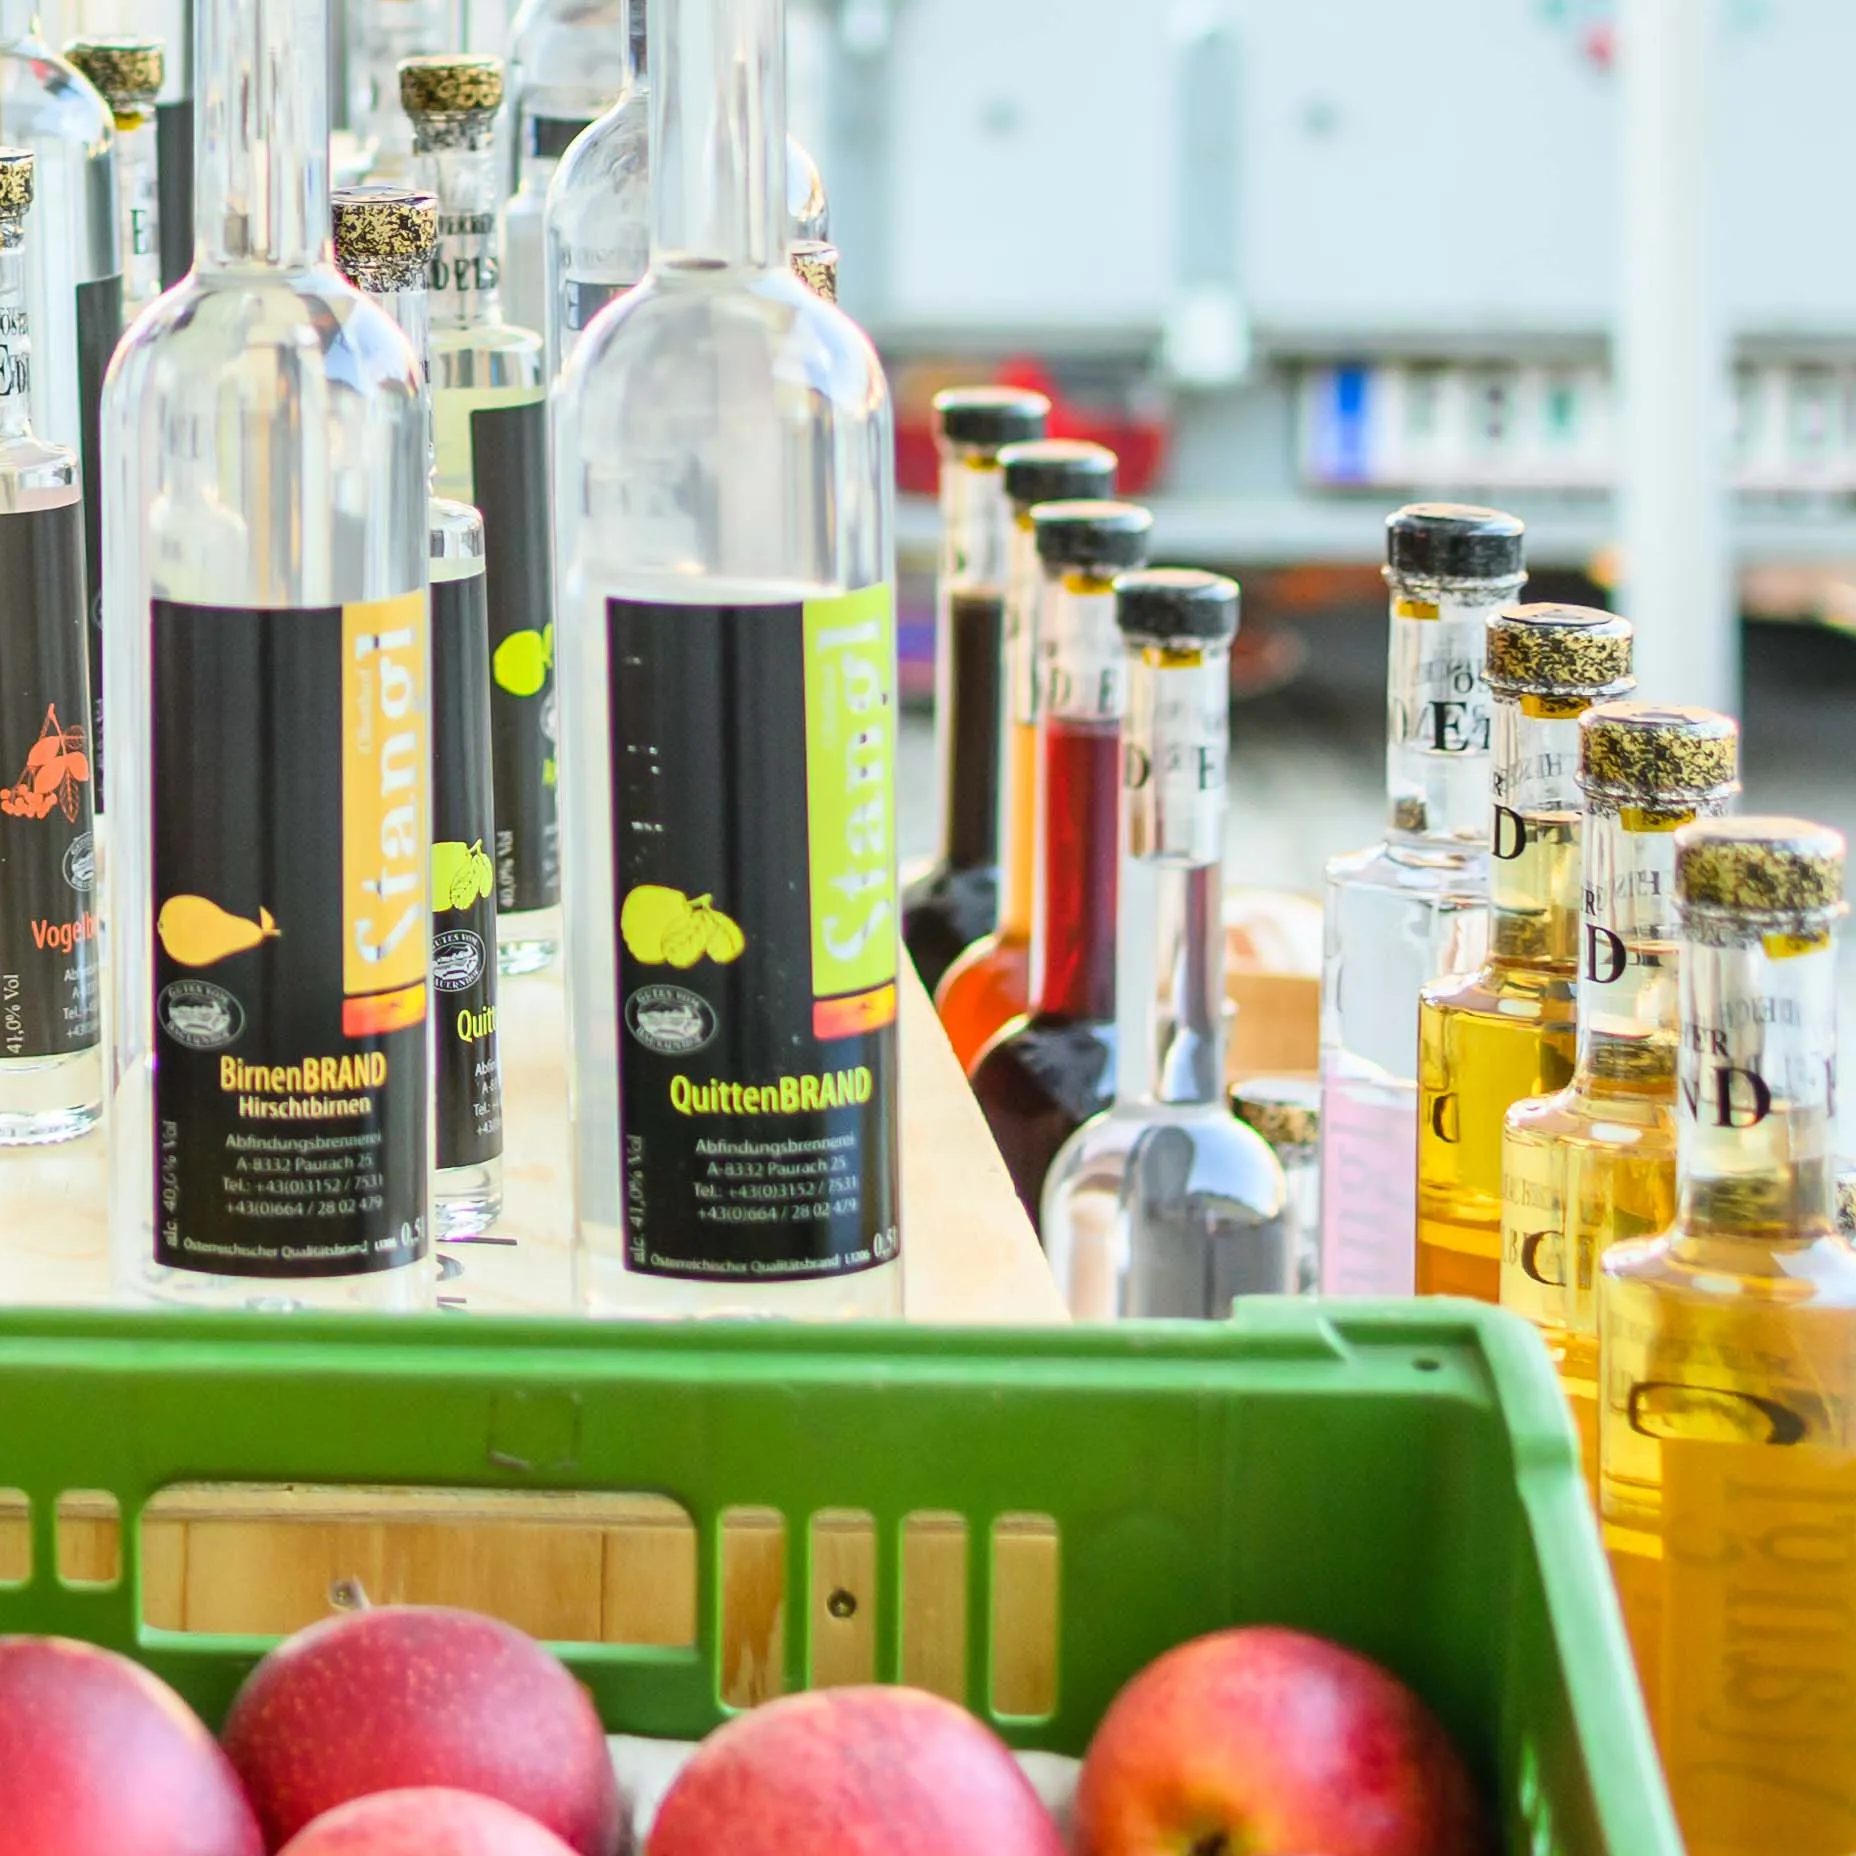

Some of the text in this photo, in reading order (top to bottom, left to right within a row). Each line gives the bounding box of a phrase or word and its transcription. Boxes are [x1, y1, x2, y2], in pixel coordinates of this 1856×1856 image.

[354, 625, 423, 965] Stangl
[816, 616, 892, 963] Stangl
[3, 973, 25, 1055] 41,0% Vol
[219, 1051, 388, 1094] BirnenBRAND
[669, 1065, 873, 1116] QuittenBRAND
[237, 1094, 372, 1120] Hirschtbirnen
[225, 1129, 382, 1153] Abfindungsbrennerei
[695, 1131, 856, 1157] Abfindungsbrennerei
[294, 1155, 355, 1172] Paurach
[706, 1154, 847, 1176] A-8332 Paurach 25
[354, 1174, 383, 1187] 7531
[317, 1200, 336, 1215] 28
[338, 1197, 356, 1213] 02
[358, 1194, 384, 1211] 479
[791, 1204, 810, 1220] 28
[812, 1201, 830, 1217] 02
